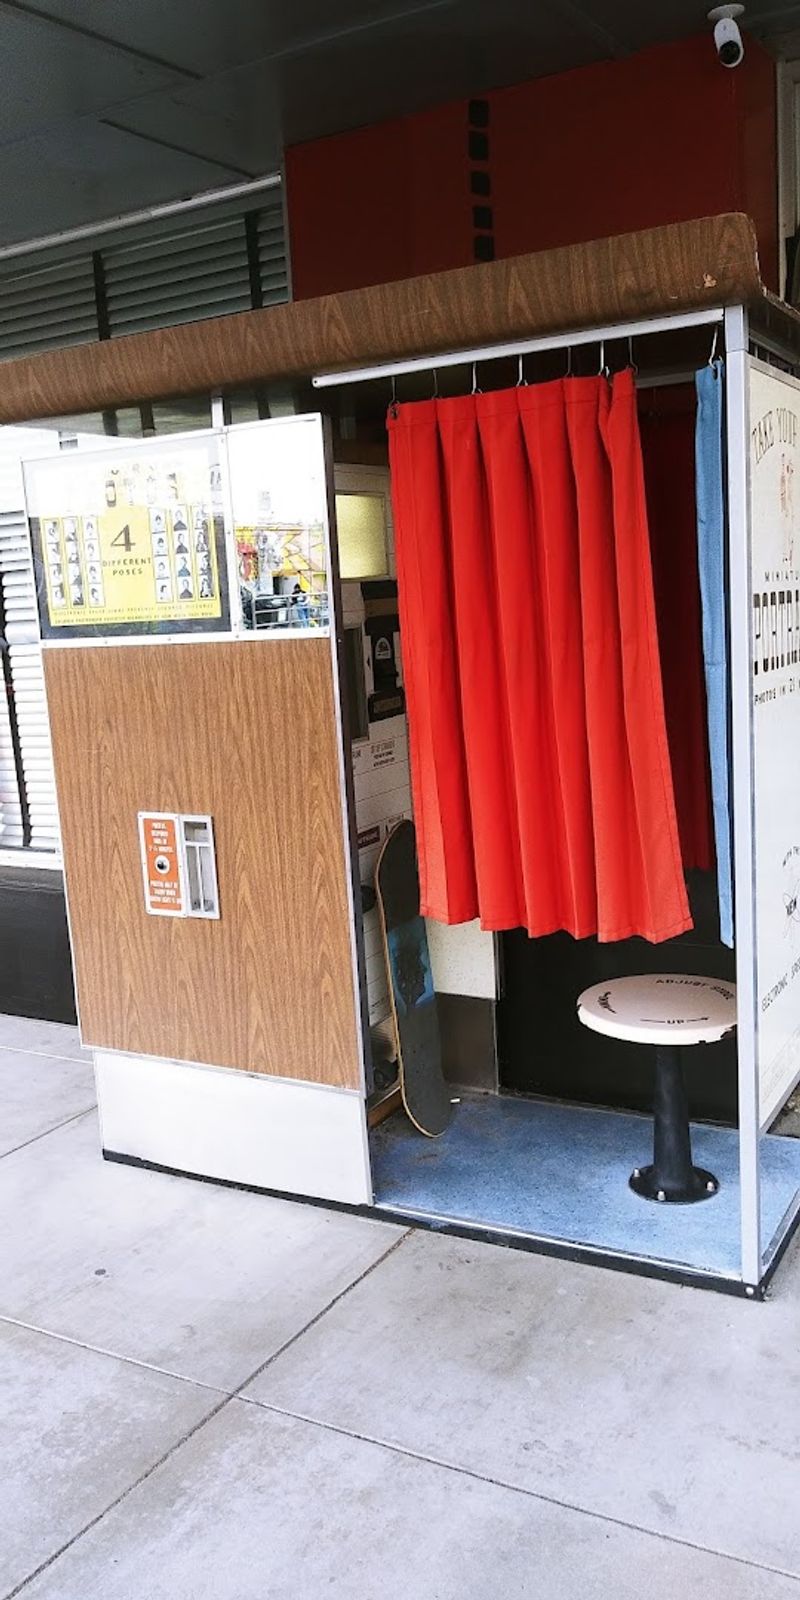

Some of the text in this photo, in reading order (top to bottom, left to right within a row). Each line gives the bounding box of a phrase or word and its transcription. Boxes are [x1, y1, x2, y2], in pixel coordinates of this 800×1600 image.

[752, 410, 774, 464] TAKE
[110, 524, 136, 552] 4
[102, 557, 152, 567] DIFFERENT
[112, 568, 143, 576] POSES
[656, 979, 709, 987] ADJUST
